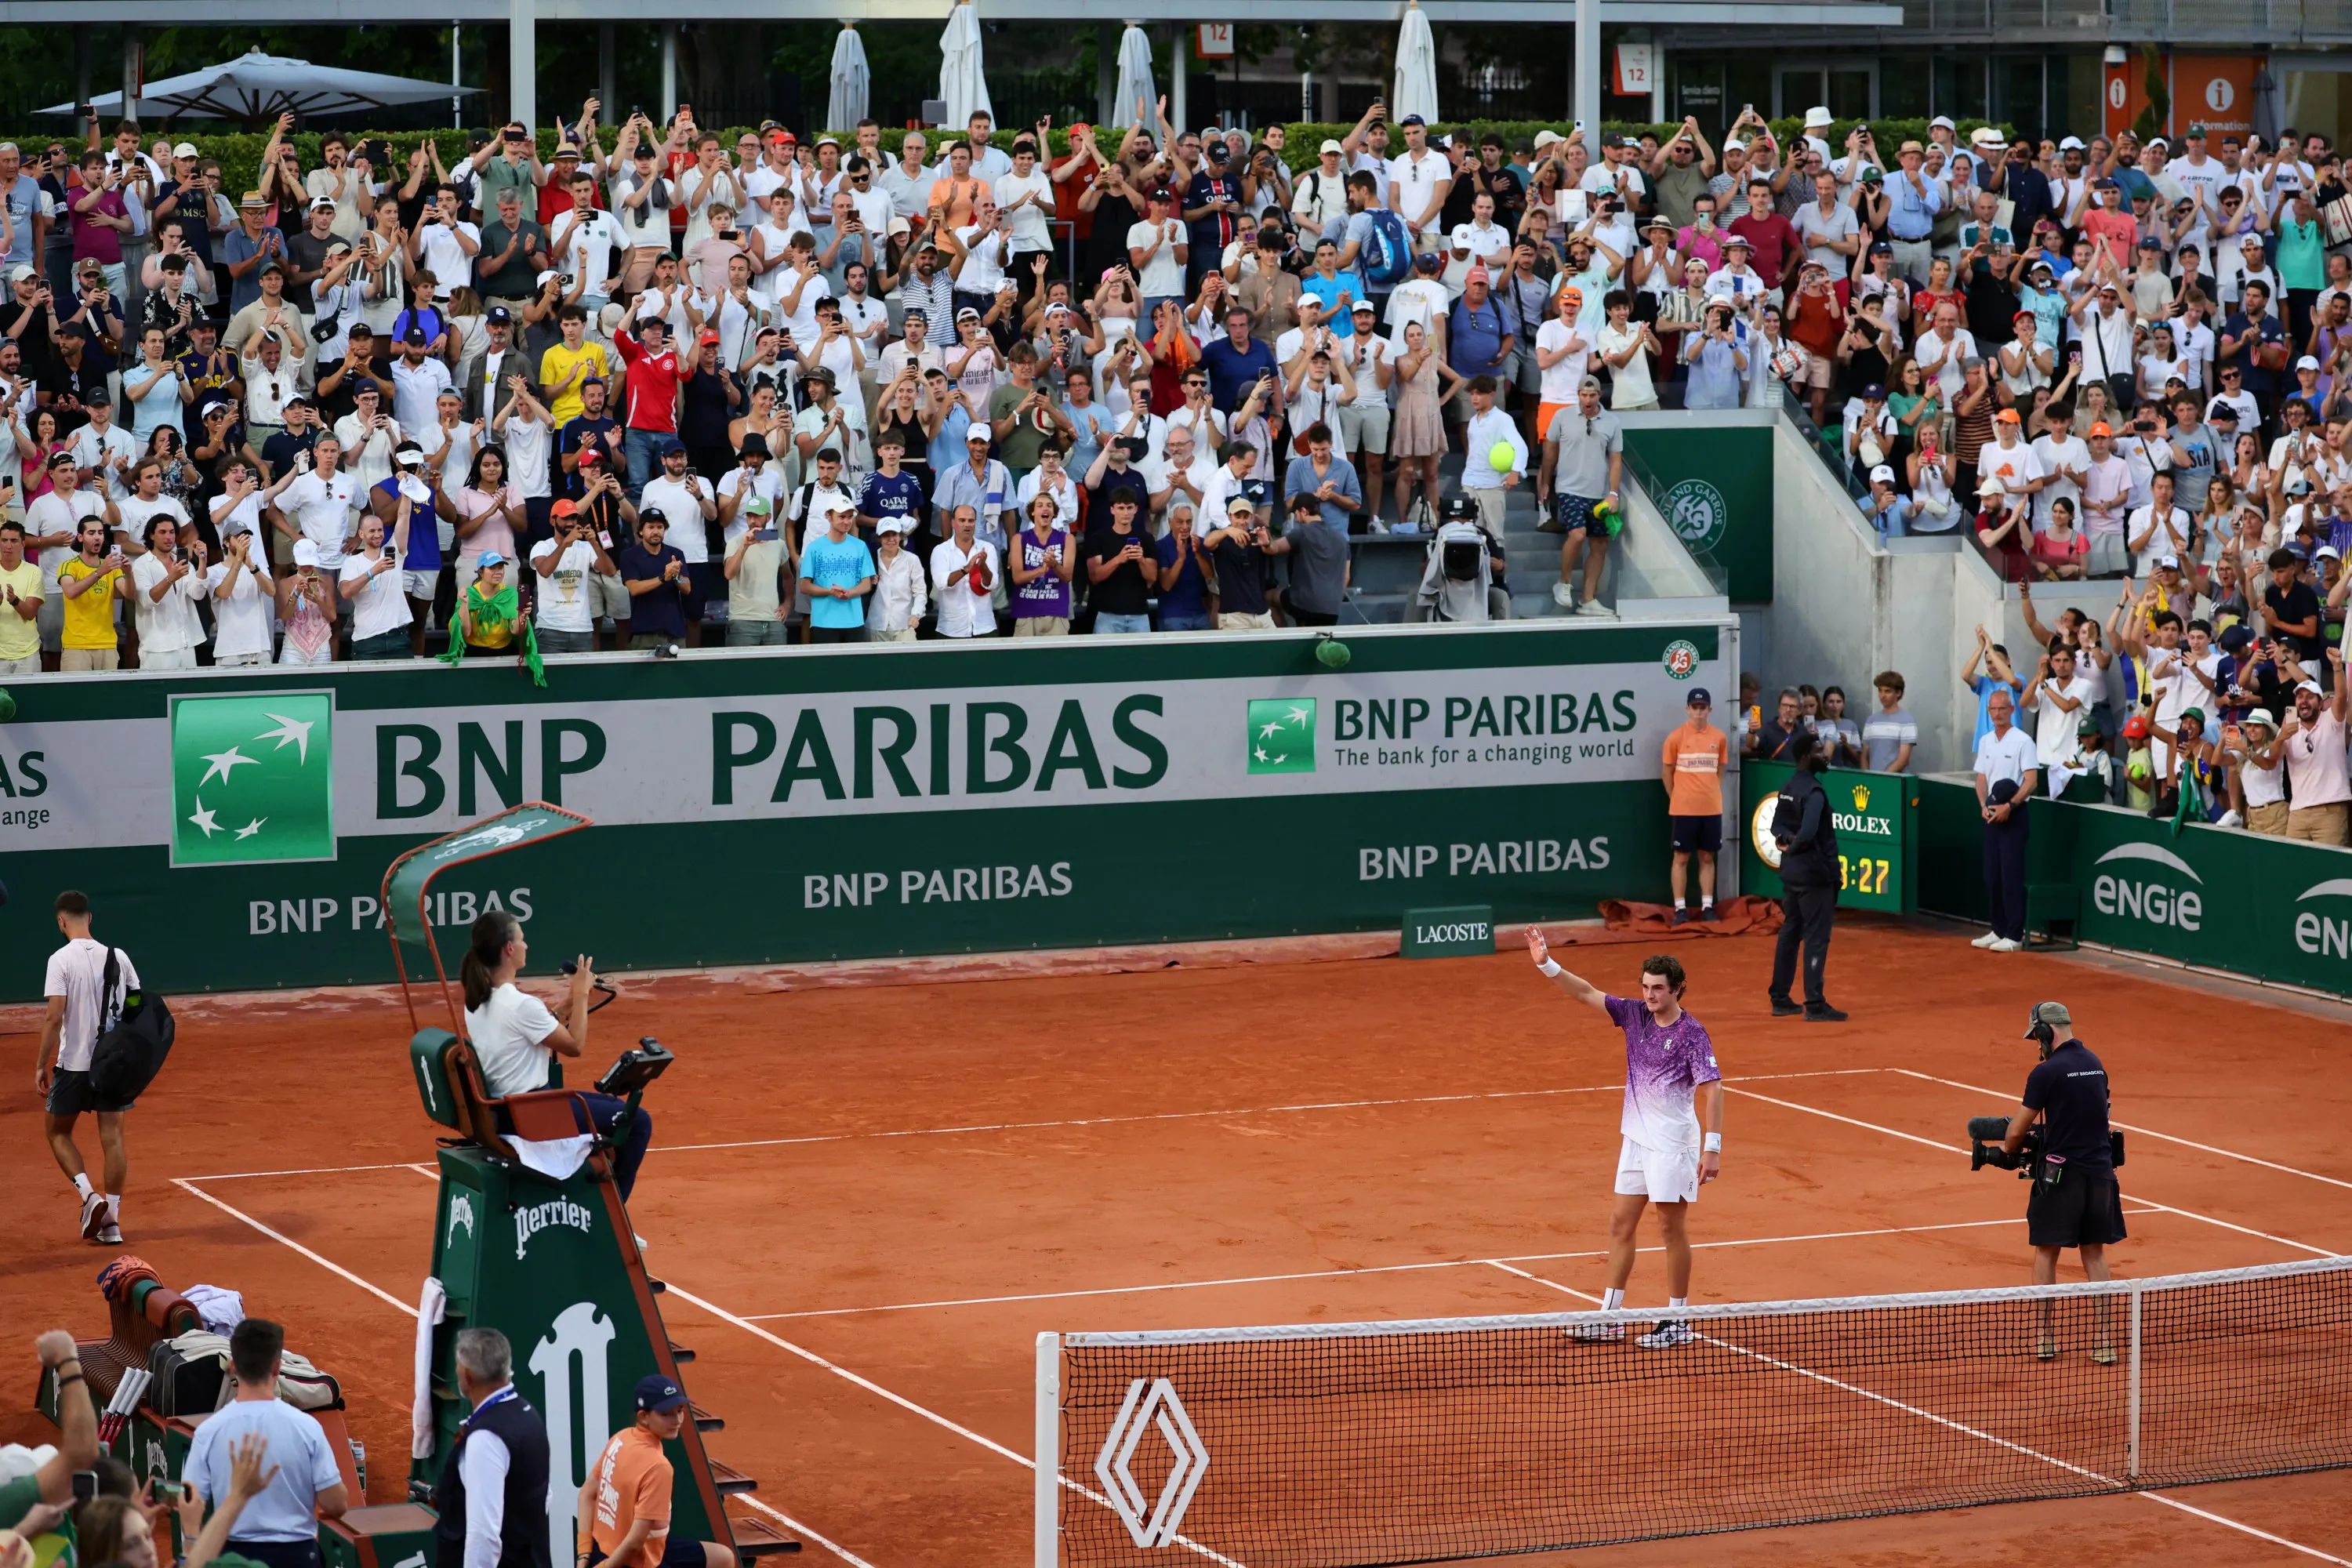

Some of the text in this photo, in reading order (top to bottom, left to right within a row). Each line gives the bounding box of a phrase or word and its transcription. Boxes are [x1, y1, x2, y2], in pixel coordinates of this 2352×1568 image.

[1628, 68, 1644, 81] 12
[183, 208, 205, 218] MSC
[880, 496, 907, 506] QATAR
[1025, 550, 1062, 562] TENS
[1335, 689, 1636, 741] BNP PARIBAS
[376, 694, 1169, 820] BNP PARIBAS
[1335, 739, 1634, 768] The bank for a changing world
[1831, 812, 1892, 835] ROLEX
[1359, 836, 1610, 880] BNP PARIBAS
[804, 862, 1073, 909] BNP PARIBAS
[249, 897, 339, 935] BNP
[1416, 921, 1488, 943] LACOSTE
